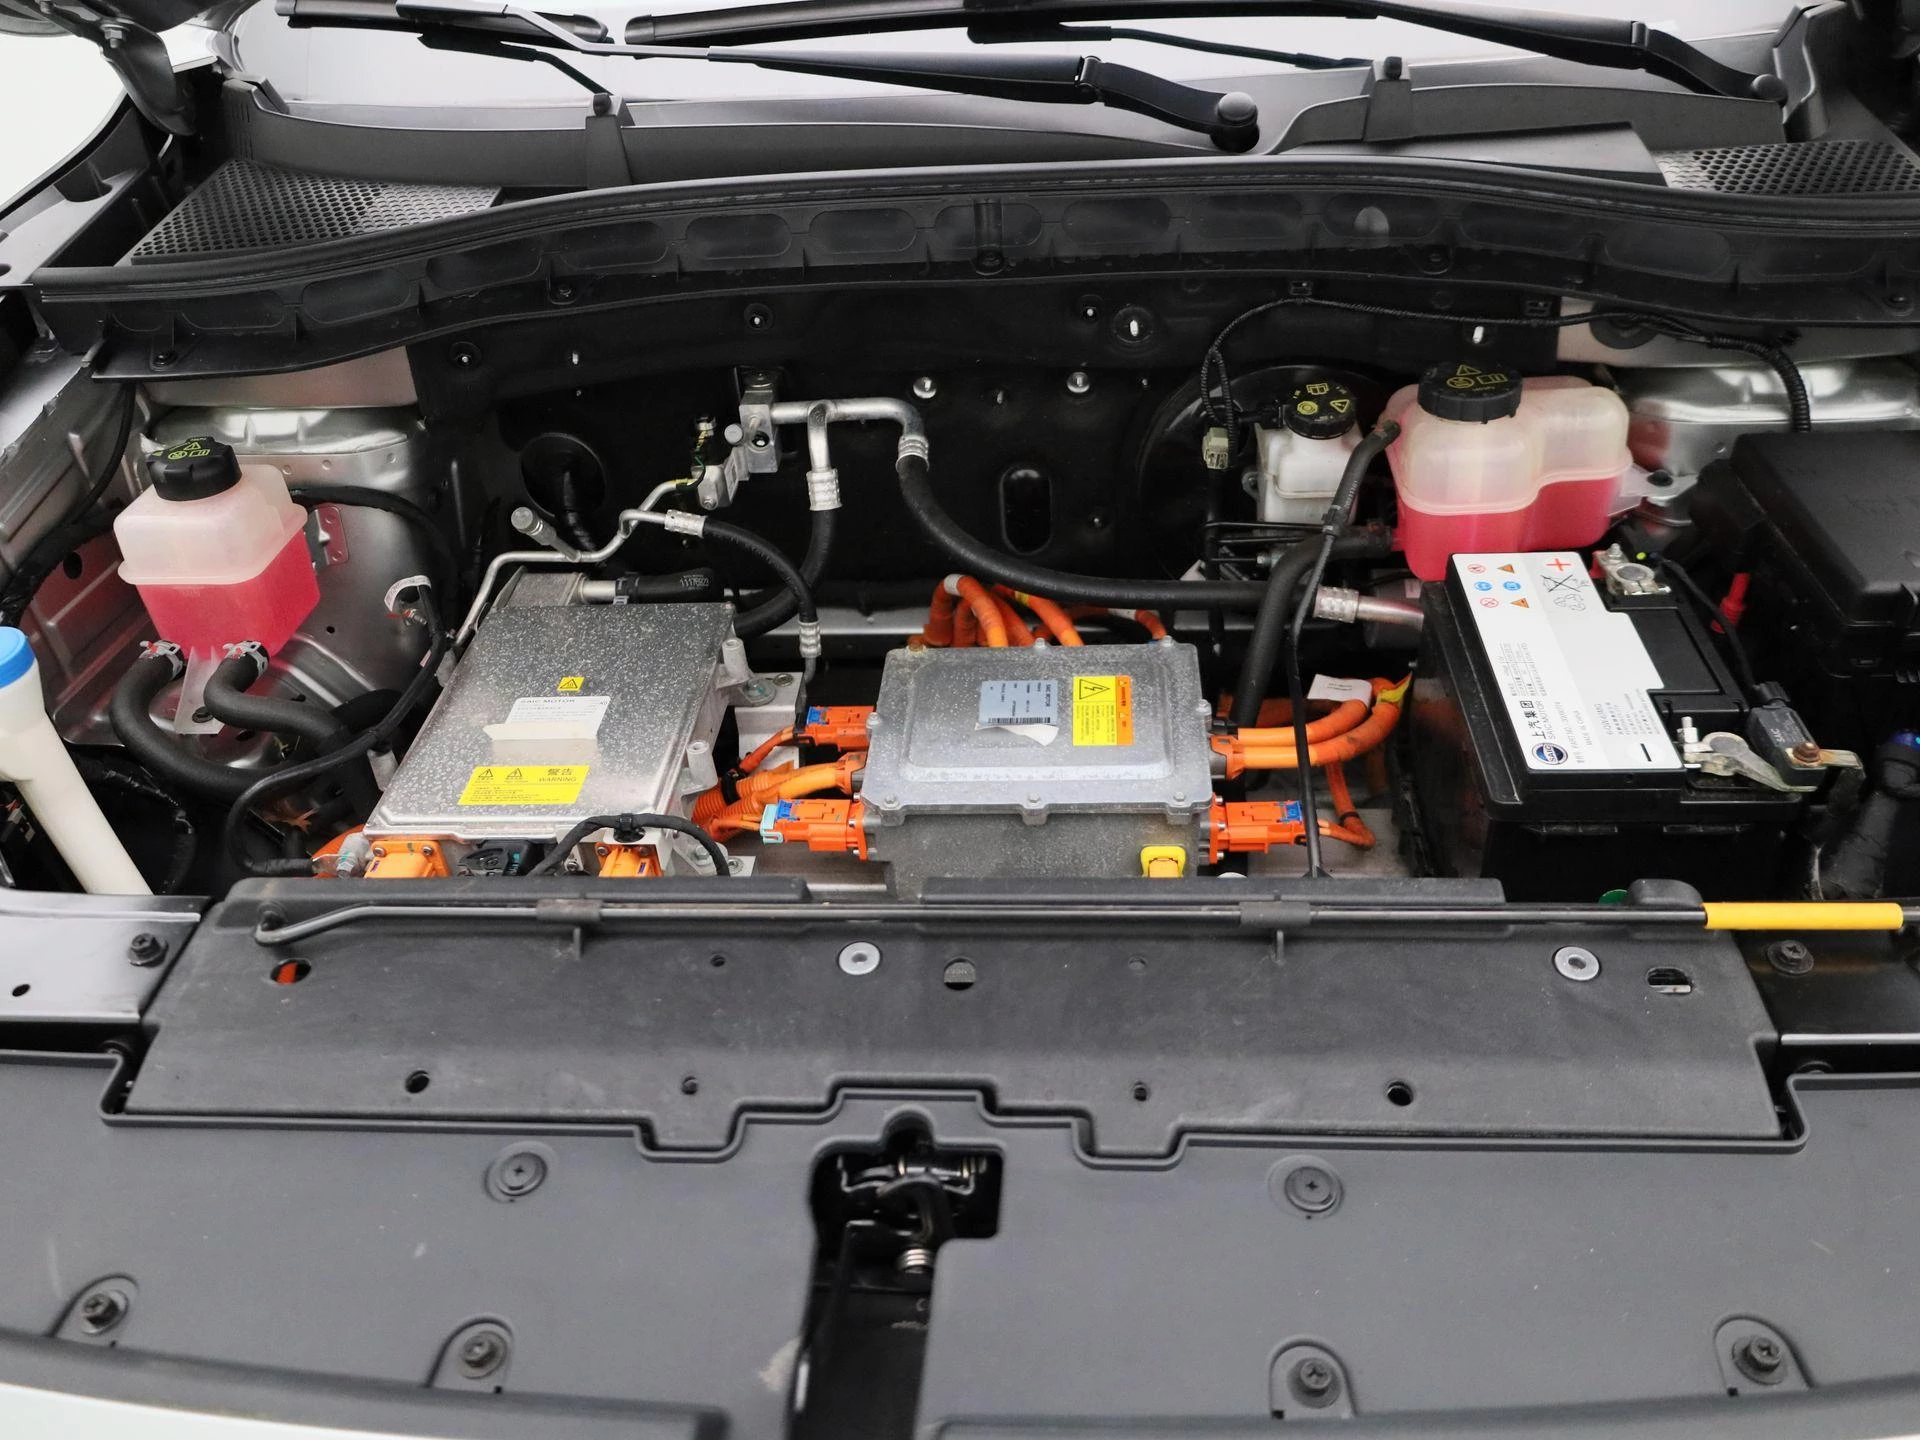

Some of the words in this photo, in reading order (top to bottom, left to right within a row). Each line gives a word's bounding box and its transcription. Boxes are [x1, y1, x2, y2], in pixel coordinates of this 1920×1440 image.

[1520, 700, 1547, 740] 上汽集团
[1535, 700, 1549, 723] MOTOR
[1544, 724, 1556, 740] SAIC
[1544, 744, 1558, 762] SAIC
